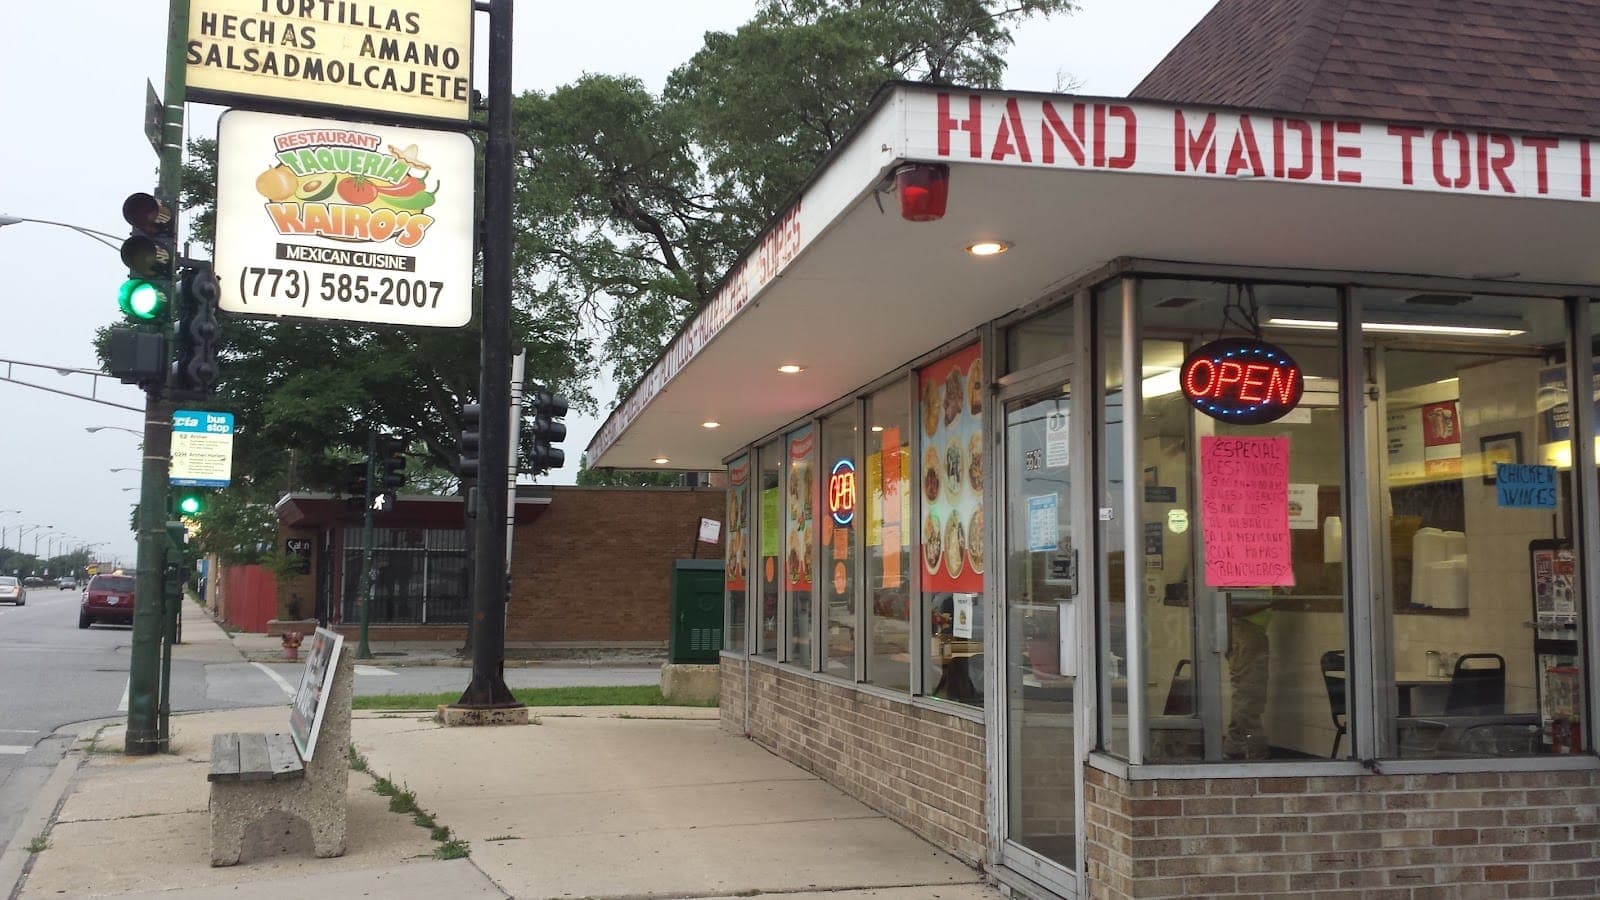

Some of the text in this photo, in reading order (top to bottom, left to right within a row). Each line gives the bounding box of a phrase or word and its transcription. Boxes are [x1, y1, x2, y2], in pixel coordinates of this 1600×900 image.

[261, 0, 420, 34] TORTILLAS
[201, 12, 460, 70] HECHAS AMANO
[276, 131, 379, 150] RESTAURANT
[937, 93, 1591, 198] HAND MADE TORTI
[278, 149, 411, 184] TAQUERIA
[266, 203, 435, 248] KAIRO'S
[759, 200, 804, 285] SOPES
[286, 245, 407, 270] MEXICAN CUISINE
[240, 266, 444, 308] (773) 585-2007
[1187, 359, 1296, 405] OPEN
[207, 415, 225, 424] bus
[207, 424, 229, 432] stop
[1213, 440, 1280, 460] ESPECIAL
[1498, 464, 1553, 484] CHICKEN
[830, 472, 856, 511] OPEN
[1502, 488, 1557, 506] WINGS
[288, 540, 310, 555] Saln
